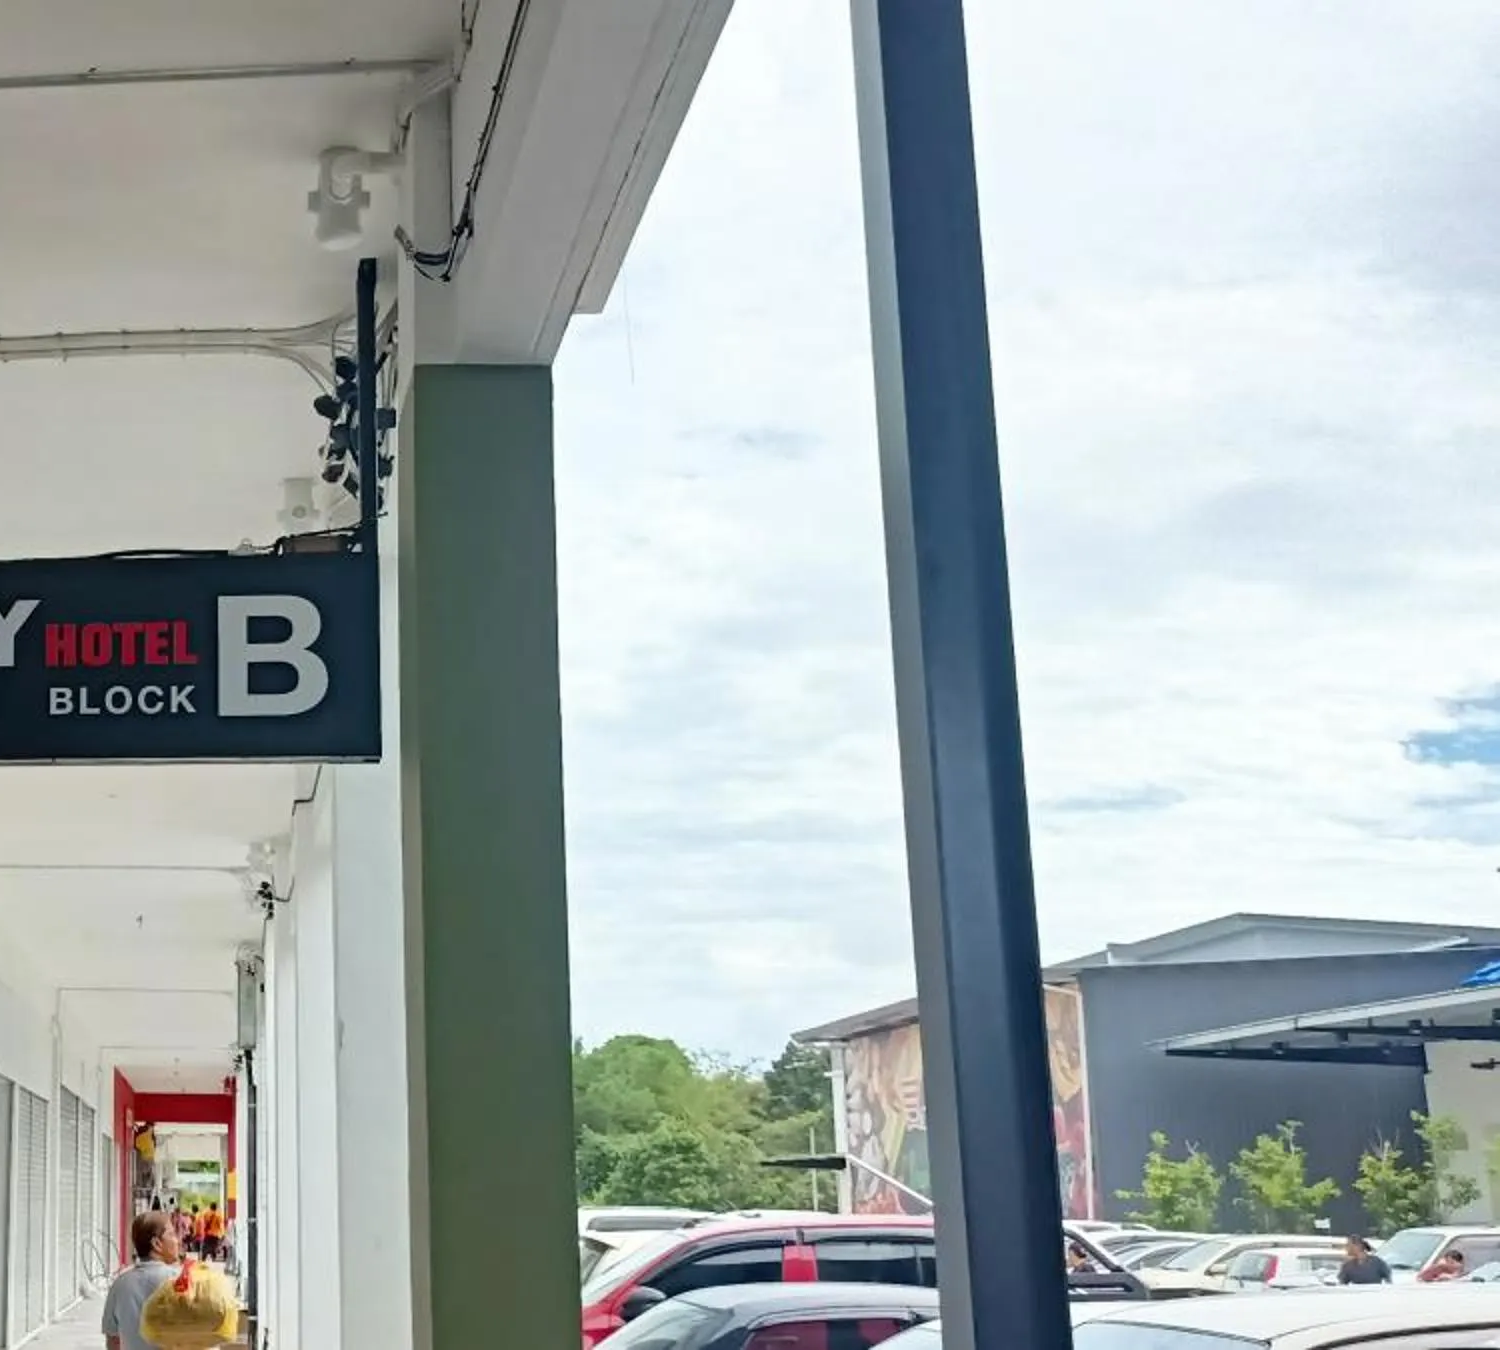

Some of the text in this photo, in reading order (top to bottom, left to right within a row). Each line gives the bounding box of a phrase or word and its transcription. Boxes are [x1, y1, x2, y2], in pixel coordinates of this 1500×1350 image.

[45, 621, 198, 666] HOTEL
[48, 594, 329, 717] BLOCK B
